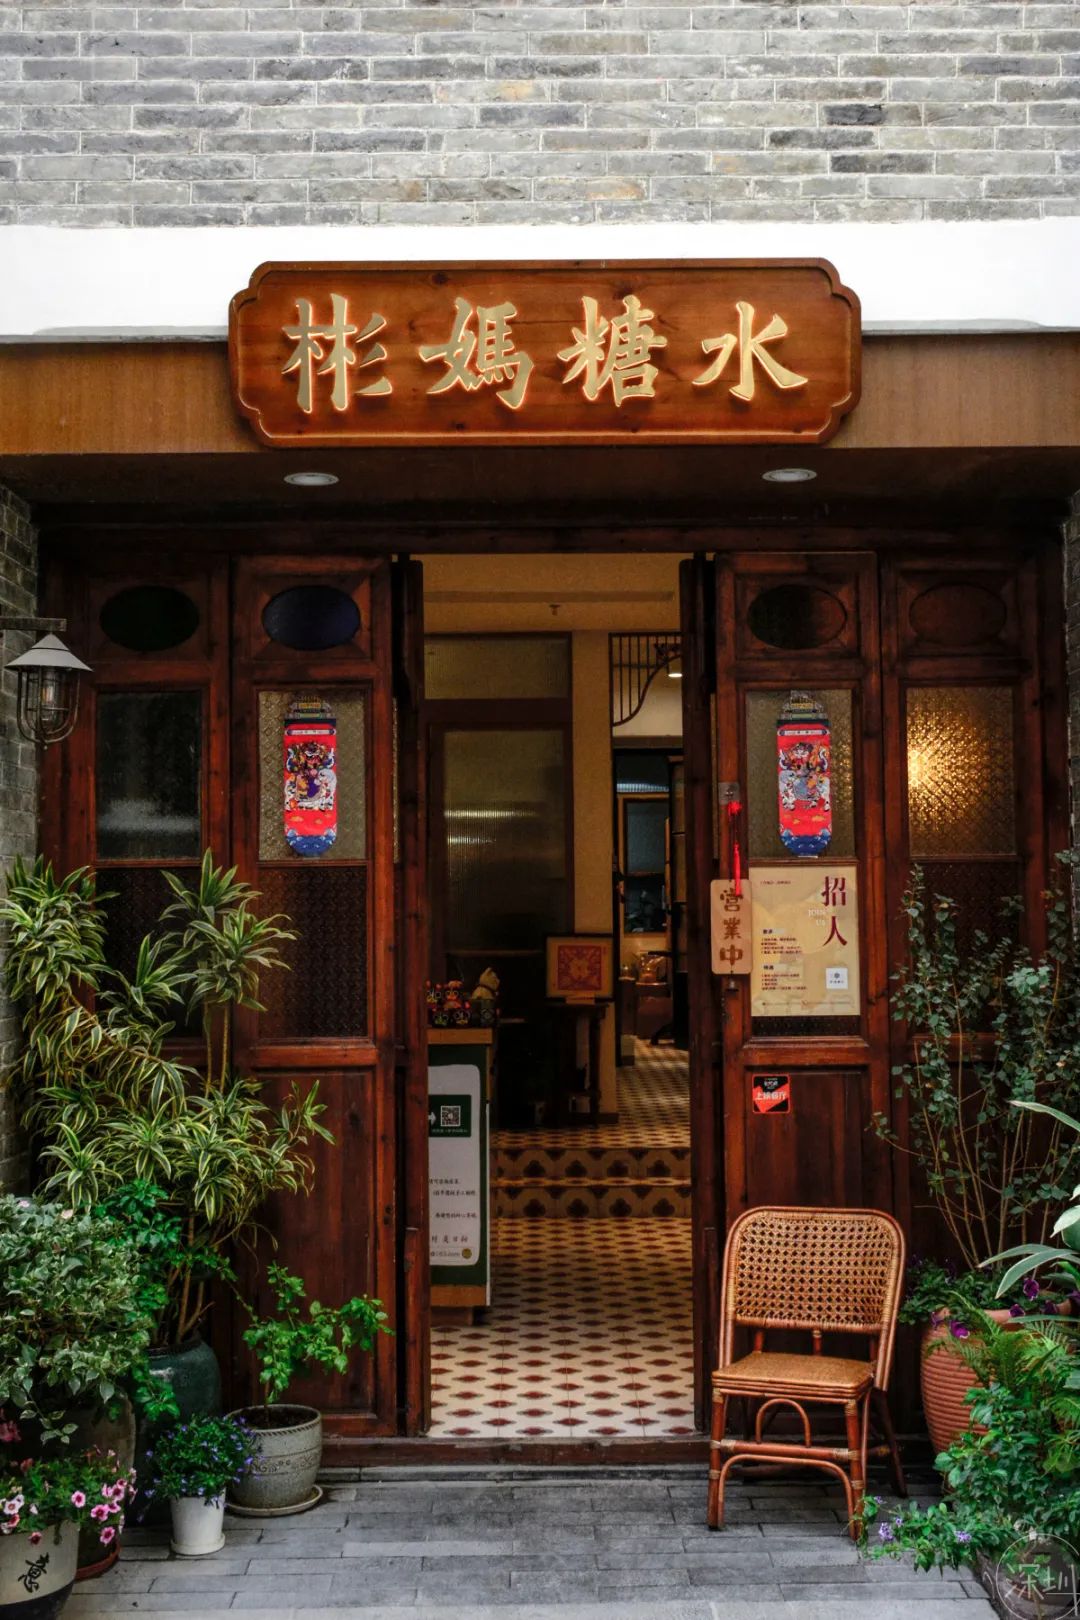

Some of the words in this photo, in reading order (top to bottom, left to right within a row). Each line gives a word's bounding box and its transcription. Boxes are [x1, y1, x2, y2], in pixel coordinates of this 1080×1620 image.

[281, 292, 809, 415] 彬媽糖水
[821, 875, 848, 947] 招人
